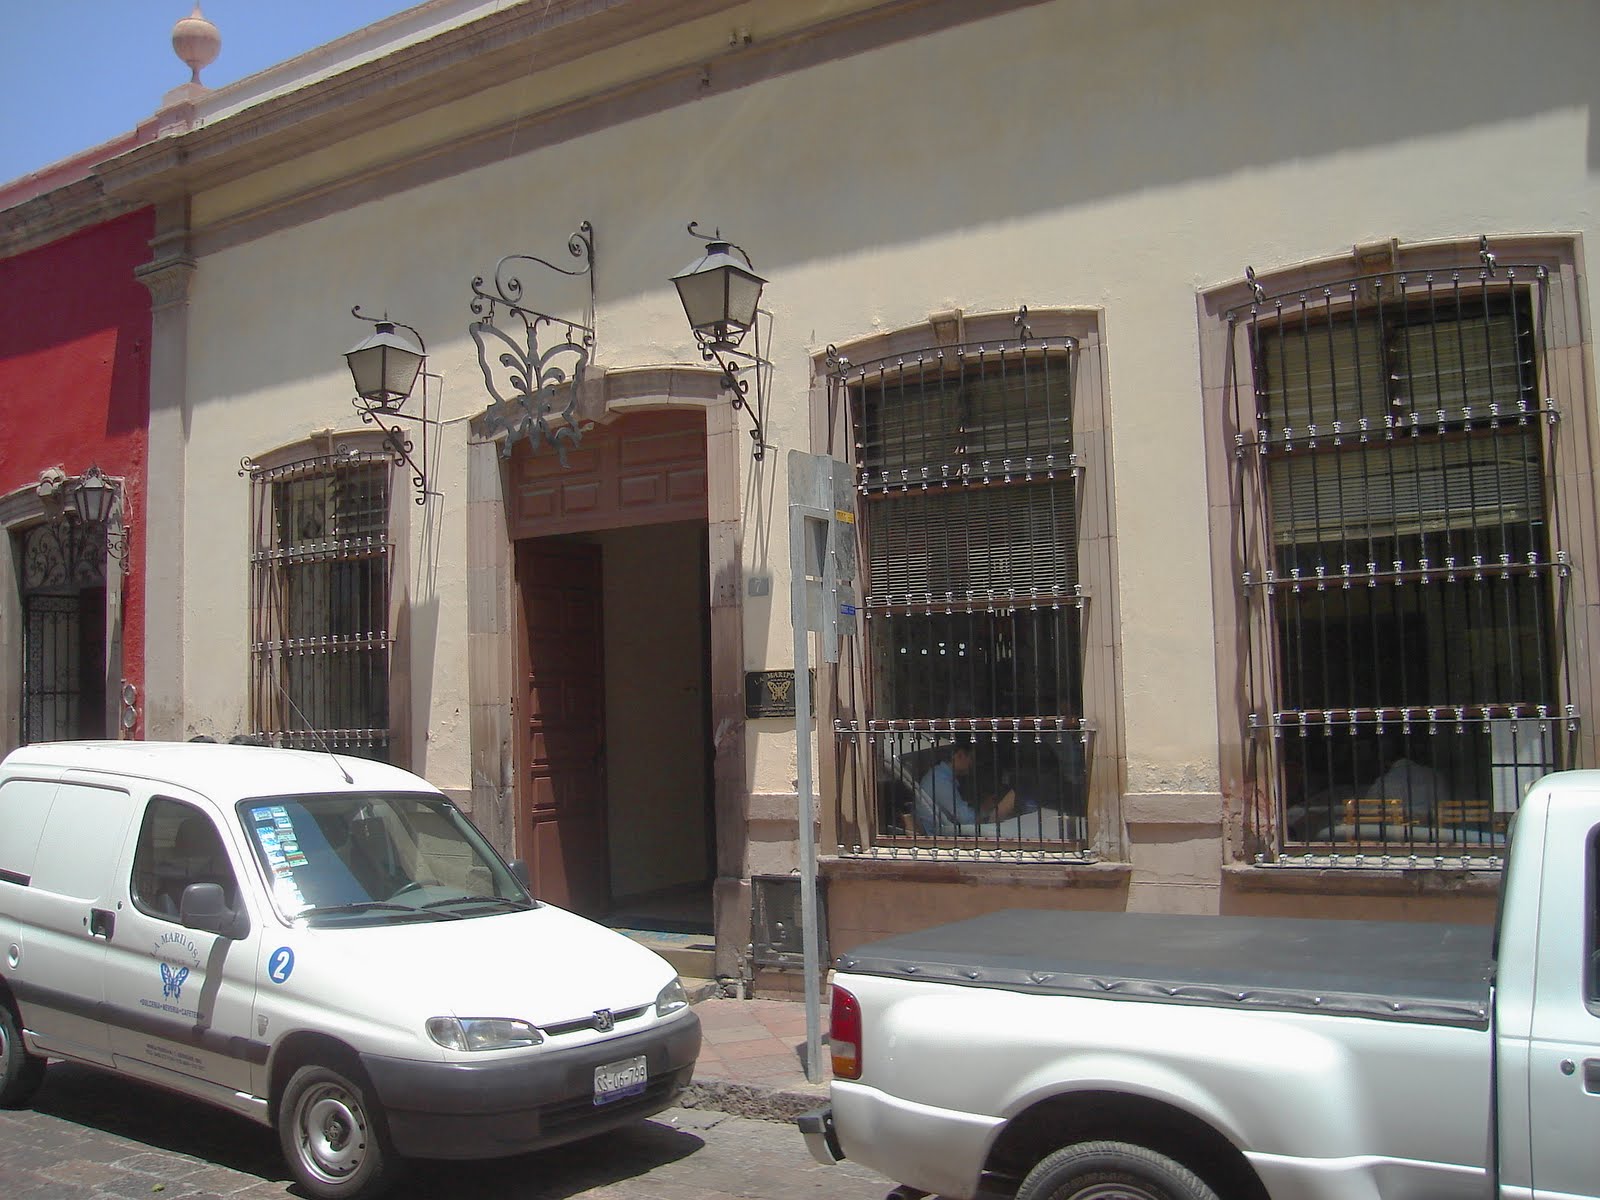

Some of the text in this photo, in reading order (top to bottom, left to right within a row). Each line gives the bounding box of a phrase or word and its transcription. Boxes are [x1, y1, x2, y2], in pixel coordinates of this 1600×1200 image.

[755, 579, 761, 593] 7
[754, 677, 765, 685] LA
[767, 671, 795, 679] MARIPO
[273, 951, 290, 980] 2
[181, 1008, 204, 1020] CAFETE
